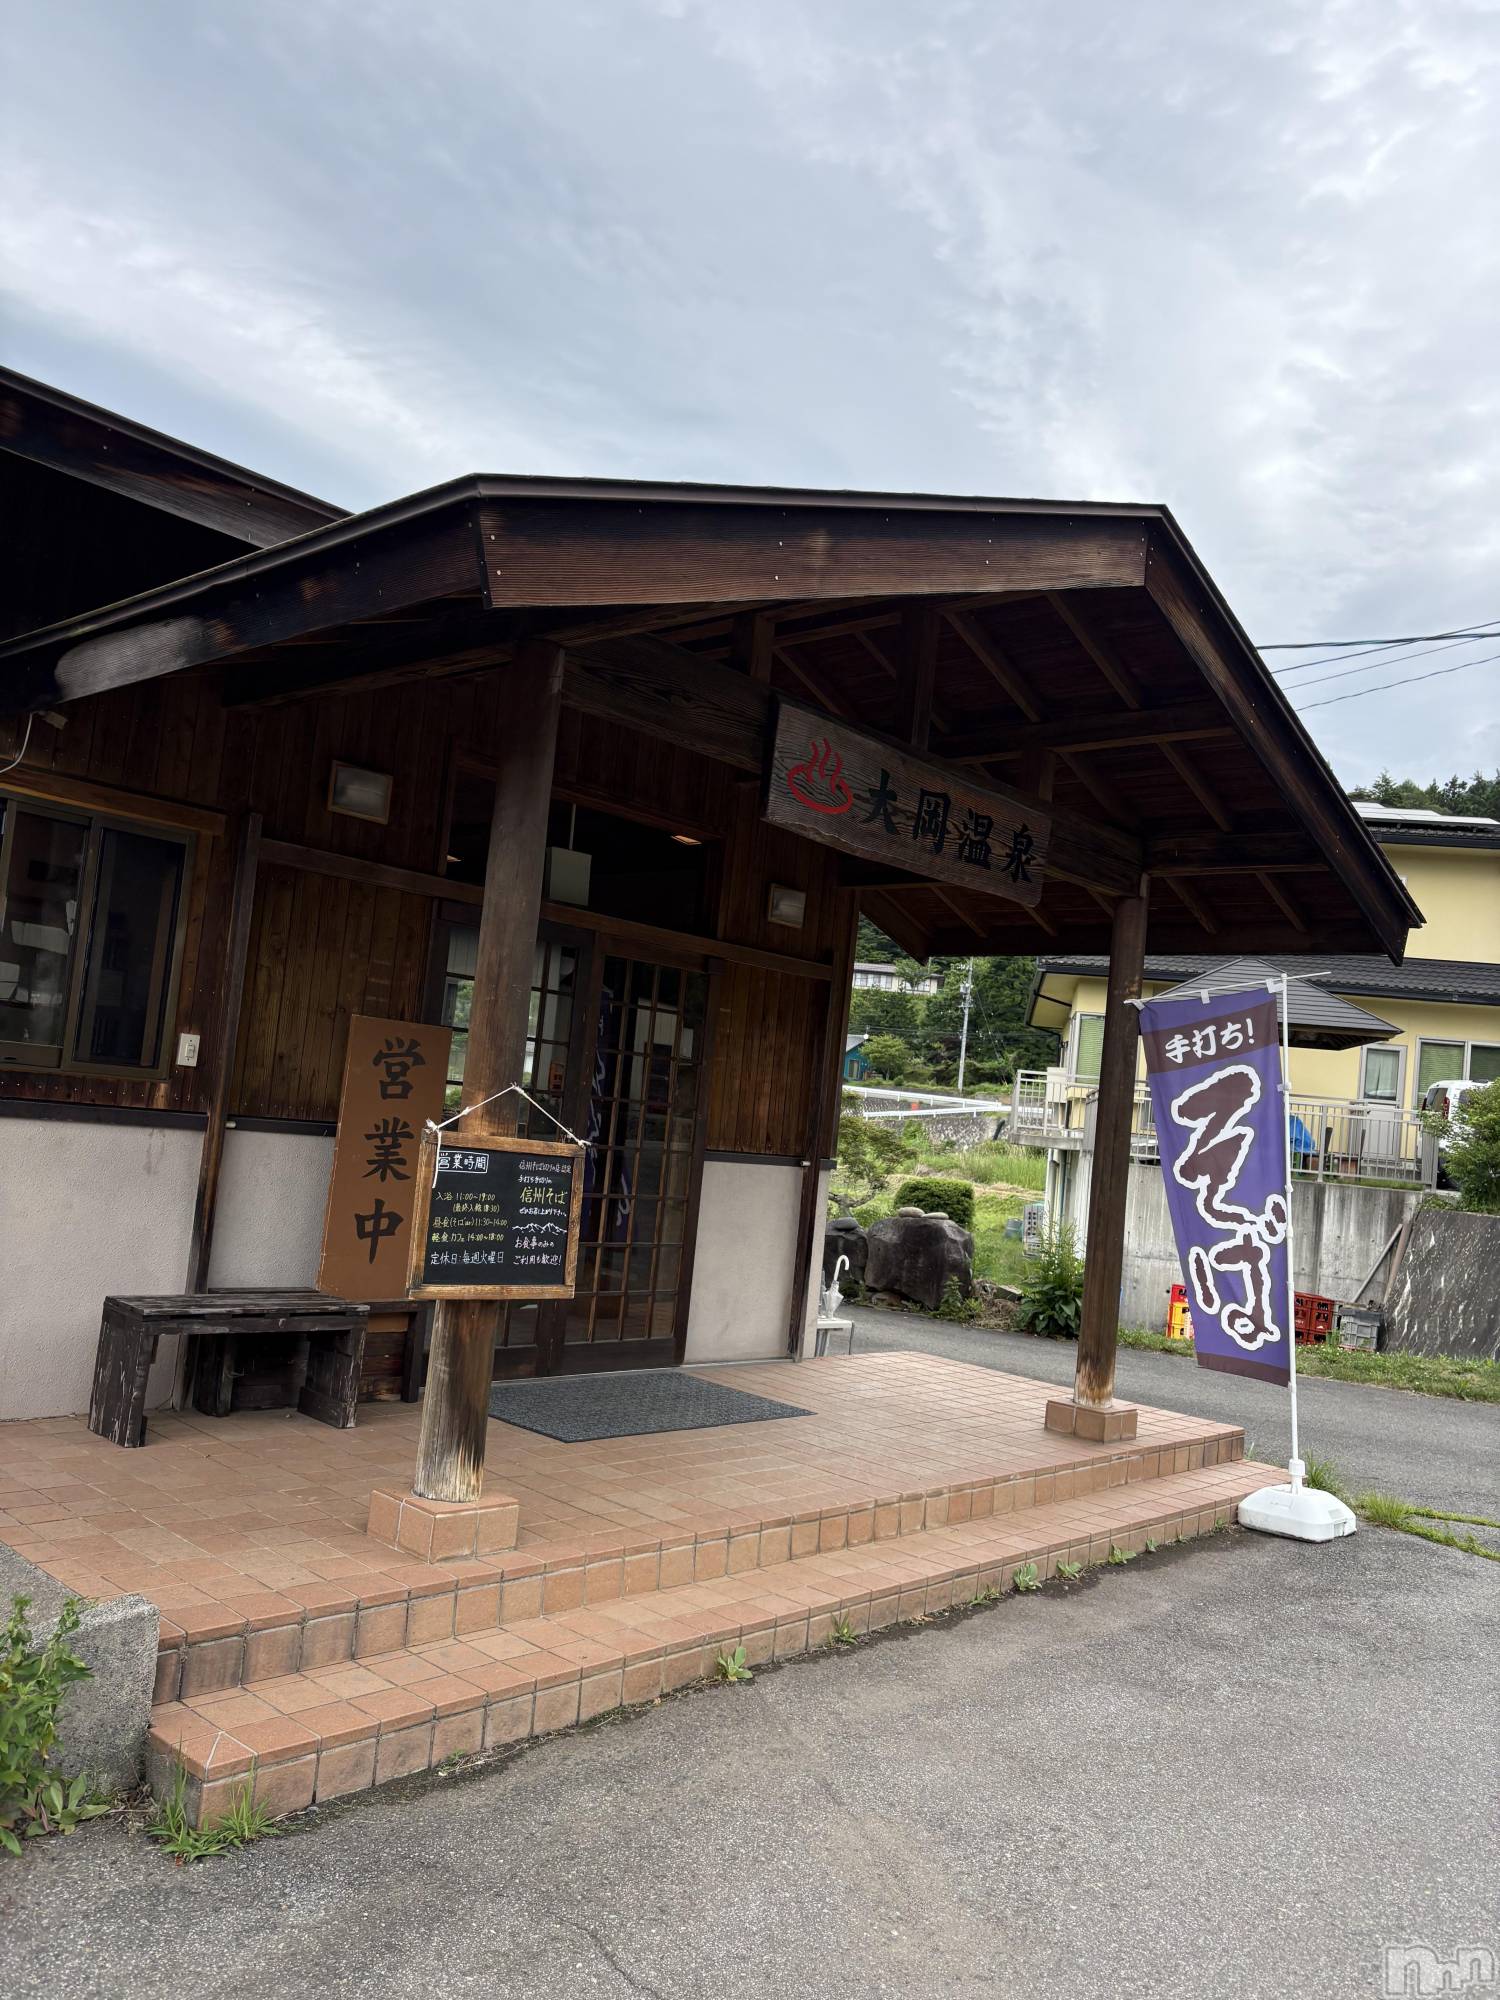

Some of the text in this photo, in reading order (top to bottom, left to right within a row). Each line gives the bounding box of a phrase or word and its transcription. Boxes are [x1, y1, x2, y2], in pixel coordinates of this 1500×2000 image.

[861, 767, 1036, 883] 大岡温泉
[1164, 1018, 1255, 1064] 手打ち!
[354, 1036, 426, 1265] 営業中
[438, 1152, 486, 1170] 営業時間
[436, 1192, 453, 1201] 入浴
[520, 1186, 569, 1205] 信州そば
[1171, 1064, 1287, 1351] そば
